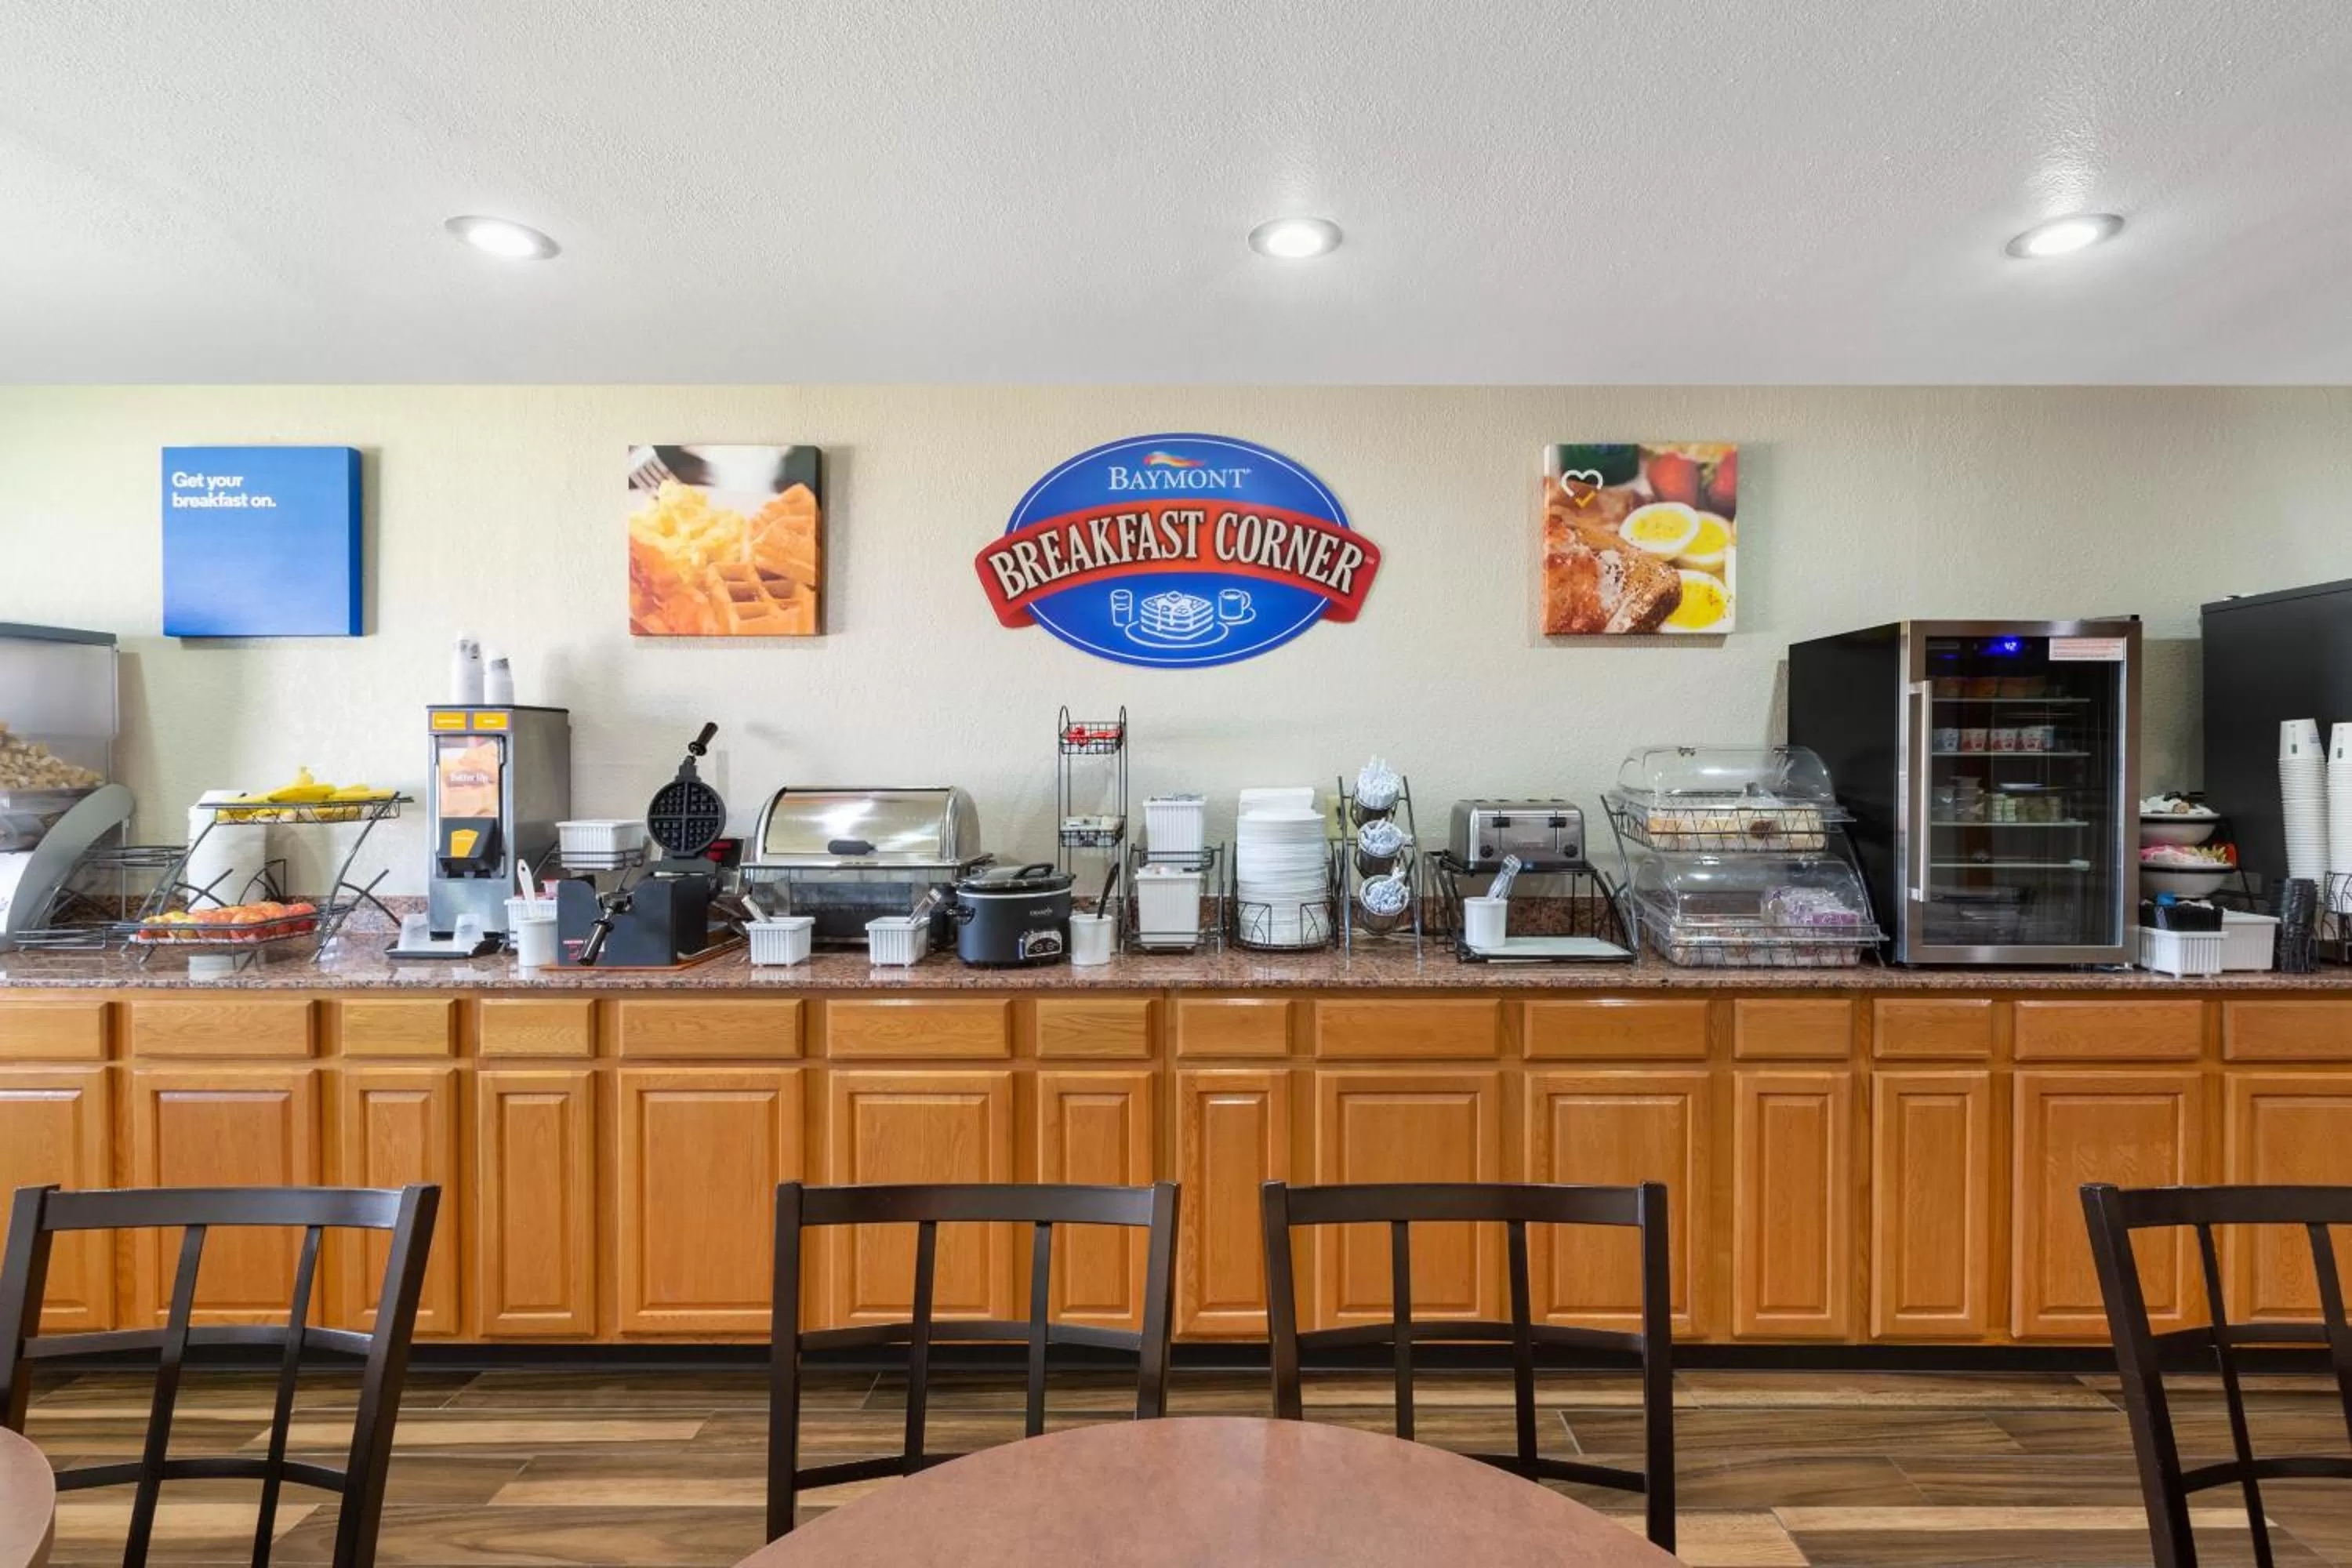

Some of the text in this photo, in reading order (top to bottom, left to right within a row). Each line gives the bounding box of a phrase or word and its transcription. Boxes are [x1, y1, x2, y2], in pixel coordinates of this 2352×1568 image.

[172, 471, 244, 490] Get your
[1108, 466, 1244, 490] BAYMONT
[172, 492, 277, 507] breakfast on.
[988, 510, 1364, 601] BREAKFAST CORNER
